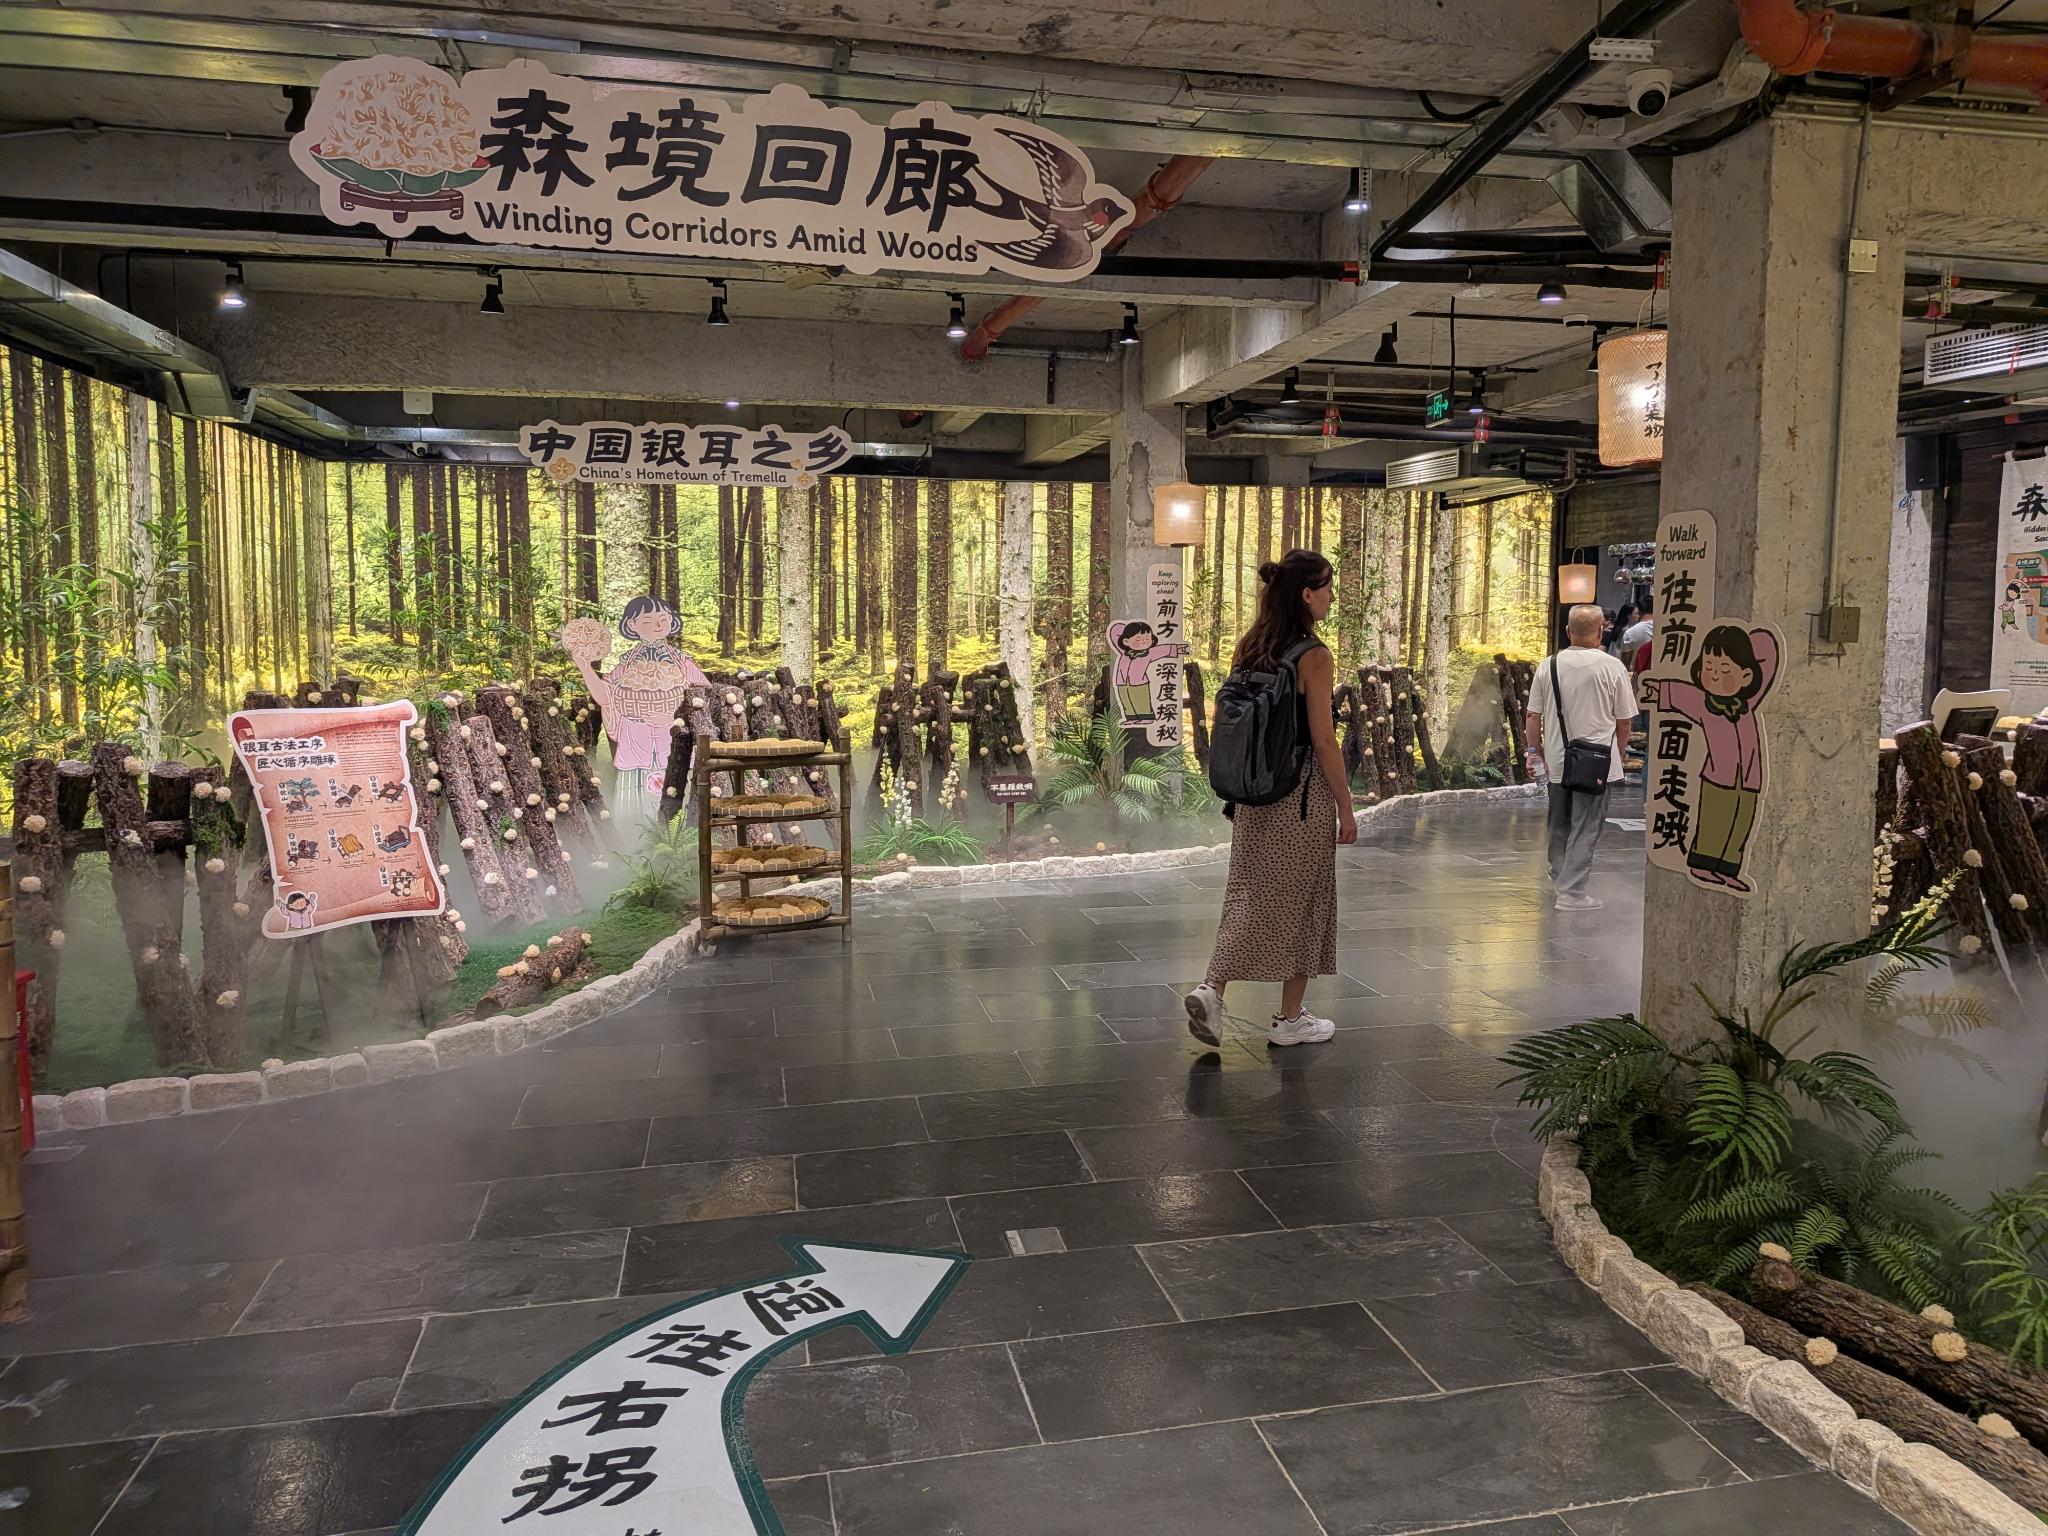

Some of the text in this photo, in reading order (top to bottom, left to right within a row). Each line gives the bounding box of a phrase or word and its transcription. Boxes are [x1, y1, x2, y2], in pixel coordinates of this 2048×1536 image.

[479, 89, 978, 233] 森境回廊
[474, 201, 979, 263] Winding Corridors Amid Woods
[528, 427, 849, 471] 中国银耳之乡
[579, 466, 787, 483] China's Hometown of Tremella
[1660, 543, 1707, 562] forward
[1669, 523, 1699, 543] Walk
[1151, 579, 1180, 588] exploring
[1158, 569, 1173, 579] Keep
[1155, 598, 1179, 742] 前方深度探秘
[1652, 569, 1698, 855] 往前面走哦
[501, 1279, 844, 1536] 逗往右拐
